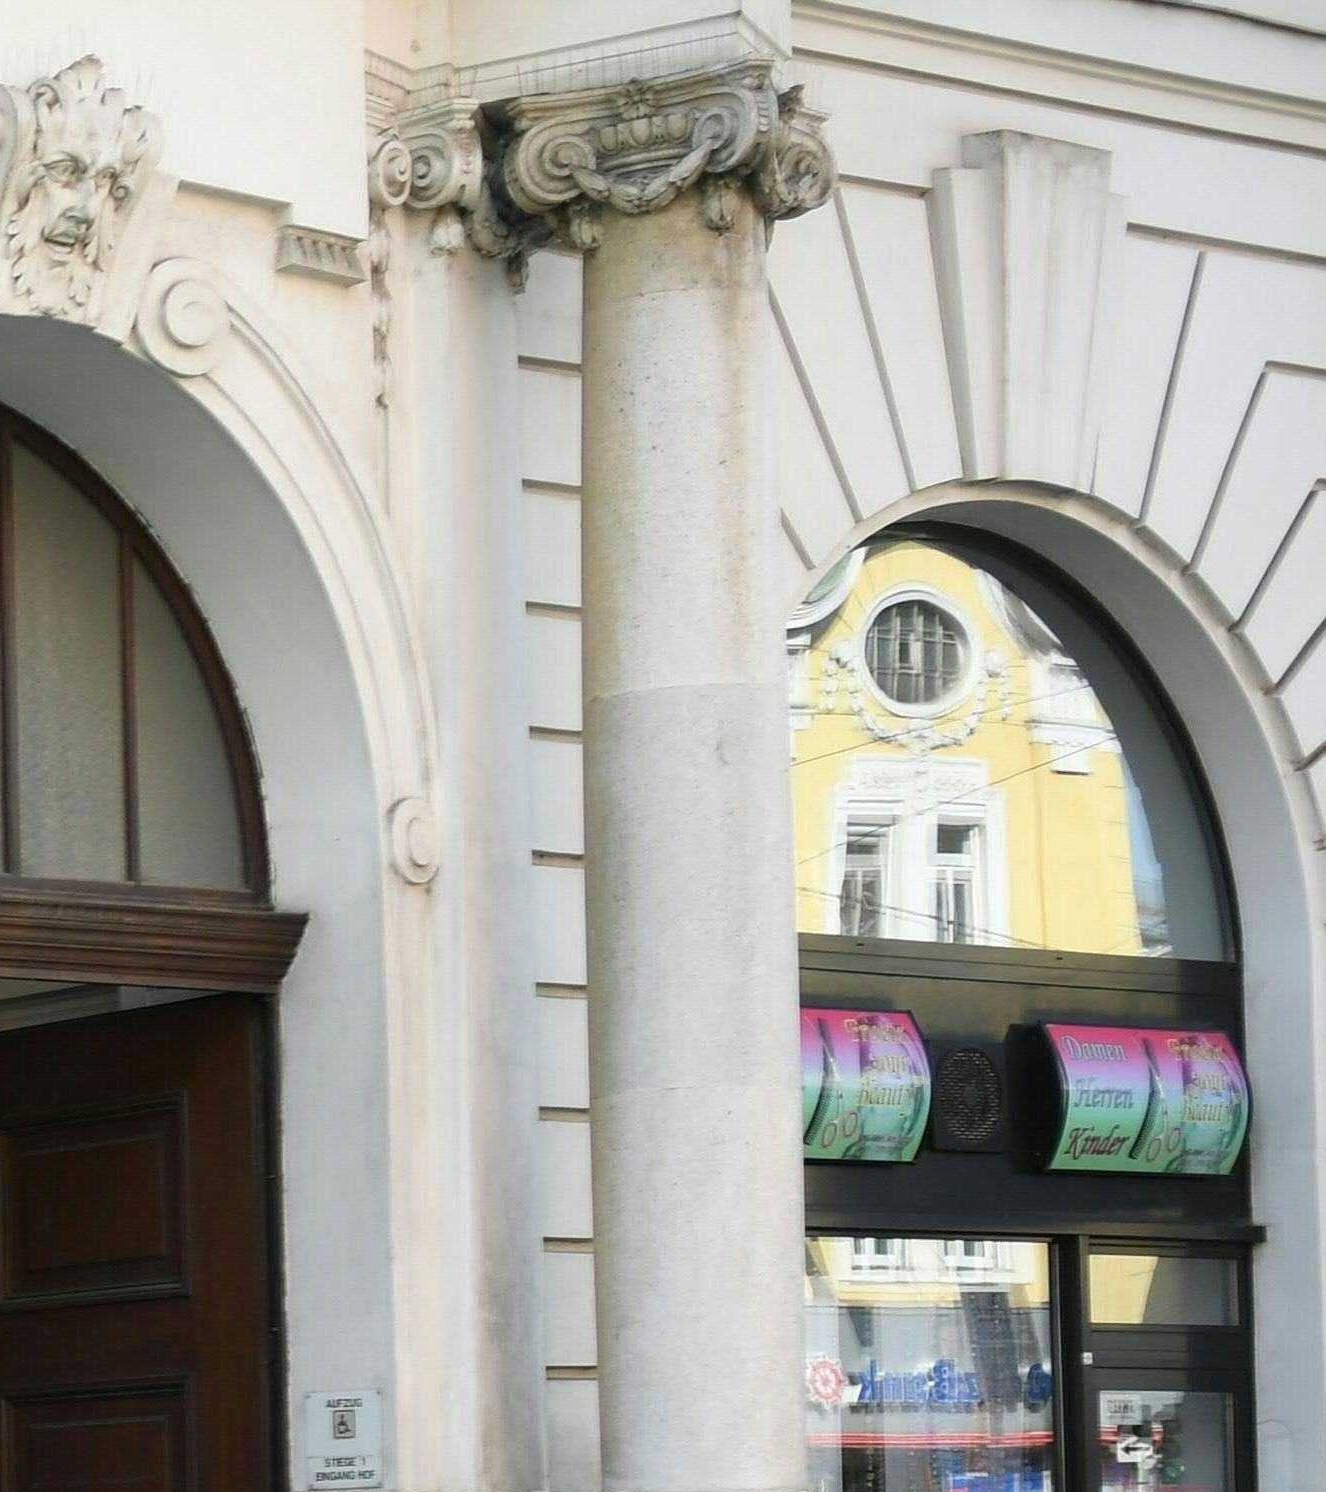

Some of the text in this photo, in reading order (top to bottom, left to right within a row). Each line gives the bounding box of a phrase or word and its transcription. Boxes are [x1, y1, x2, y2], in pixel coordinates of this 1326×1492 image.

[1063, 1035, 1128, 1062] Damen
[1073, 1077, 1135, 1109] Herren
[1063, 1123, 1131, 1160] Kinder
[326, 1398, 363, 1408] AUFZUG
